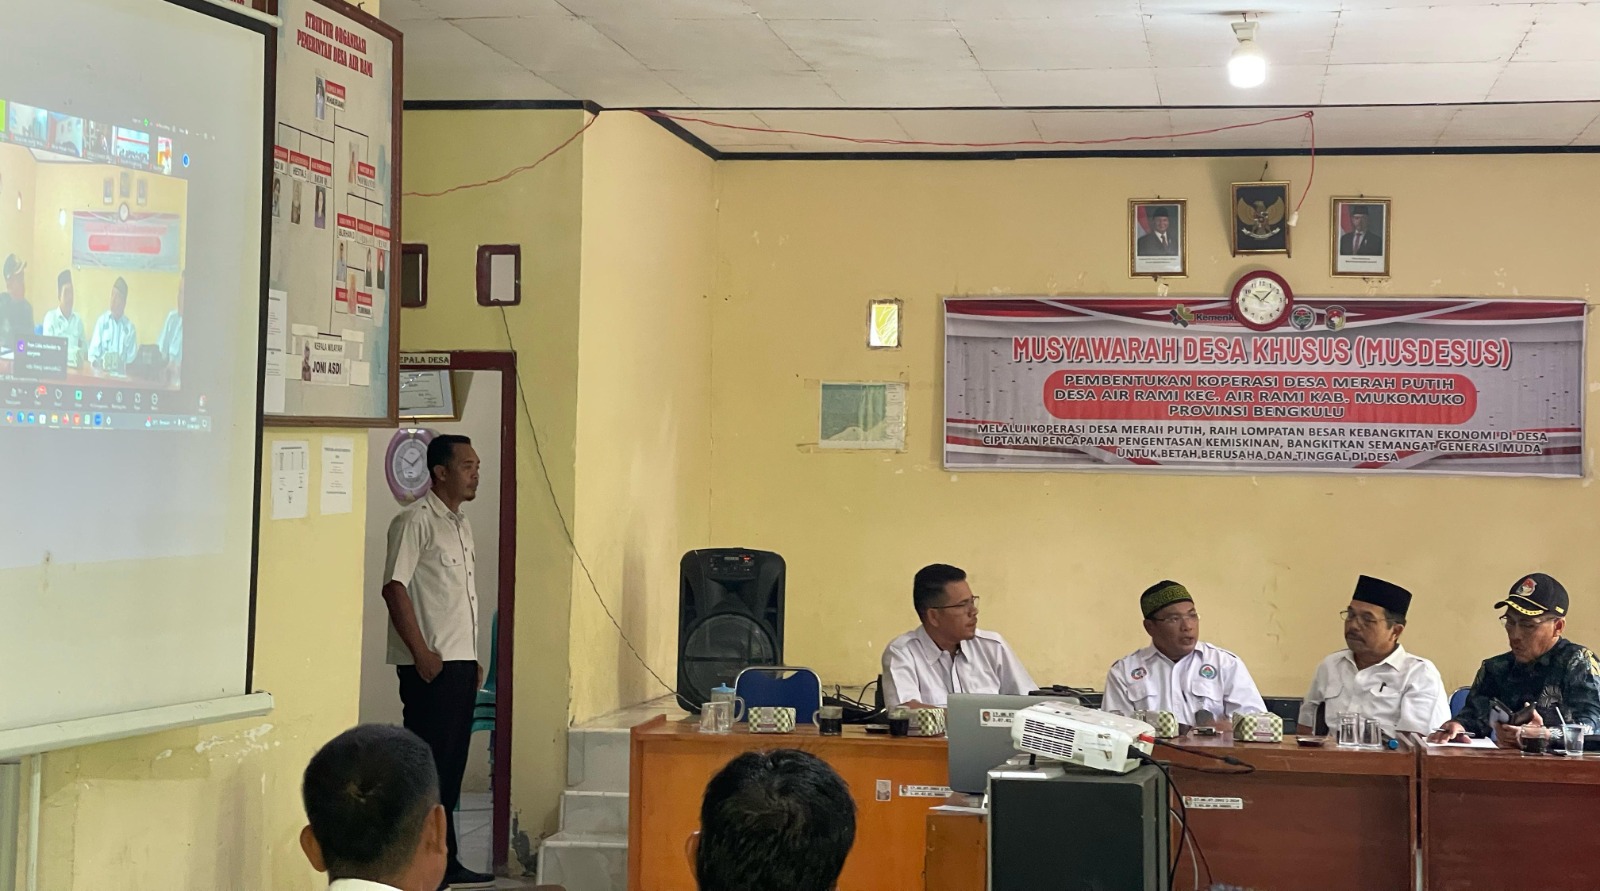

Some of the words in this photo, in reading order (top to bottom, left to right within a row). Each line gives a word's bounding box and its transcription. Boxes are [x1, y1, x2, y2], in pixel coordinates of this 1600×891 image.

[333, 46, 347, 66] DESA
[348, 53, 358, 72] AIR
[1014, 336, 1178, 362] MUSYAWARAH
[1184, 337, 1246, 363] DESA
[1252, 337, 1350, 364] KHUSUS
[1355, 336, 1512, 369] (MUSDESUS)
[312, 361, 326, 374] JONI
[328, 362, 342, 375] ASDI
[1064, 374, 1192, 388] PEMBENTUKAN
[1196, 375, 1278, 388] KOPERASI
[1284, 376, 1327, 388] DESA
[1333, 378, 1396, 389] MERAH
[1402, 378, 1455, 390] PUTIH
[1054, 390, 1097, 401] DESA
[1101, 390, 1130, 401] AIR
[1134, 390, 1180, 402] RAMI
[1184, 390, 1220, 402] KEC.
[1225, 391, 1253, 402] AIR
[1258, 392, 1305, 404] RAMI
[1309, 392, 1349, 404] KAB.
[1355, 393, 1465, 406] MUKOMUKO
[1169, 404, 1247, 417] PROVINSI
[1253, 406, 1344, 418] BENGKULU
[978, 424, 1027, 433] MELALUI
[1030, 424, 1085, 434] KOPERASI
[1089, 425, 1117, 434] DESA
[1122, 426, 1163, 434] MERAH
[1168, 426, 1206, 436] PUTIH,
[1210, 426, 1237, 435] RAIH
[1242, 427, 1304, 436] LOMPATAN
[1309, 428, 1345, 436] BESAR
[1350, 428, 1433, 438] KEBANGKITAN
[1438, 430, 1496, 440] EKONOMI
[1500, 432, 1512, 440] DI
[1517, 432, 1548, 441] DESA
[983, 436, 1038, 445] CIPTAKAN
[1043, 436, 1114, 445] PENCAPAIAN
[1119, 437, 1201, 446] PENGENTASAN
[1206, 438, 1283, 449] KEMISKINAN,
[1288, 440, 1364, 449] BANGKITKAN
[1368, 441, 1434, 450] SEMANGAT
[1440, 442, 1498, 452] GENERASI
[1503, 444, 1541, 452] MUDA
[1118, 449, 1157, 458] UNTUK
[1368, 453, 1398, 461] DESA
